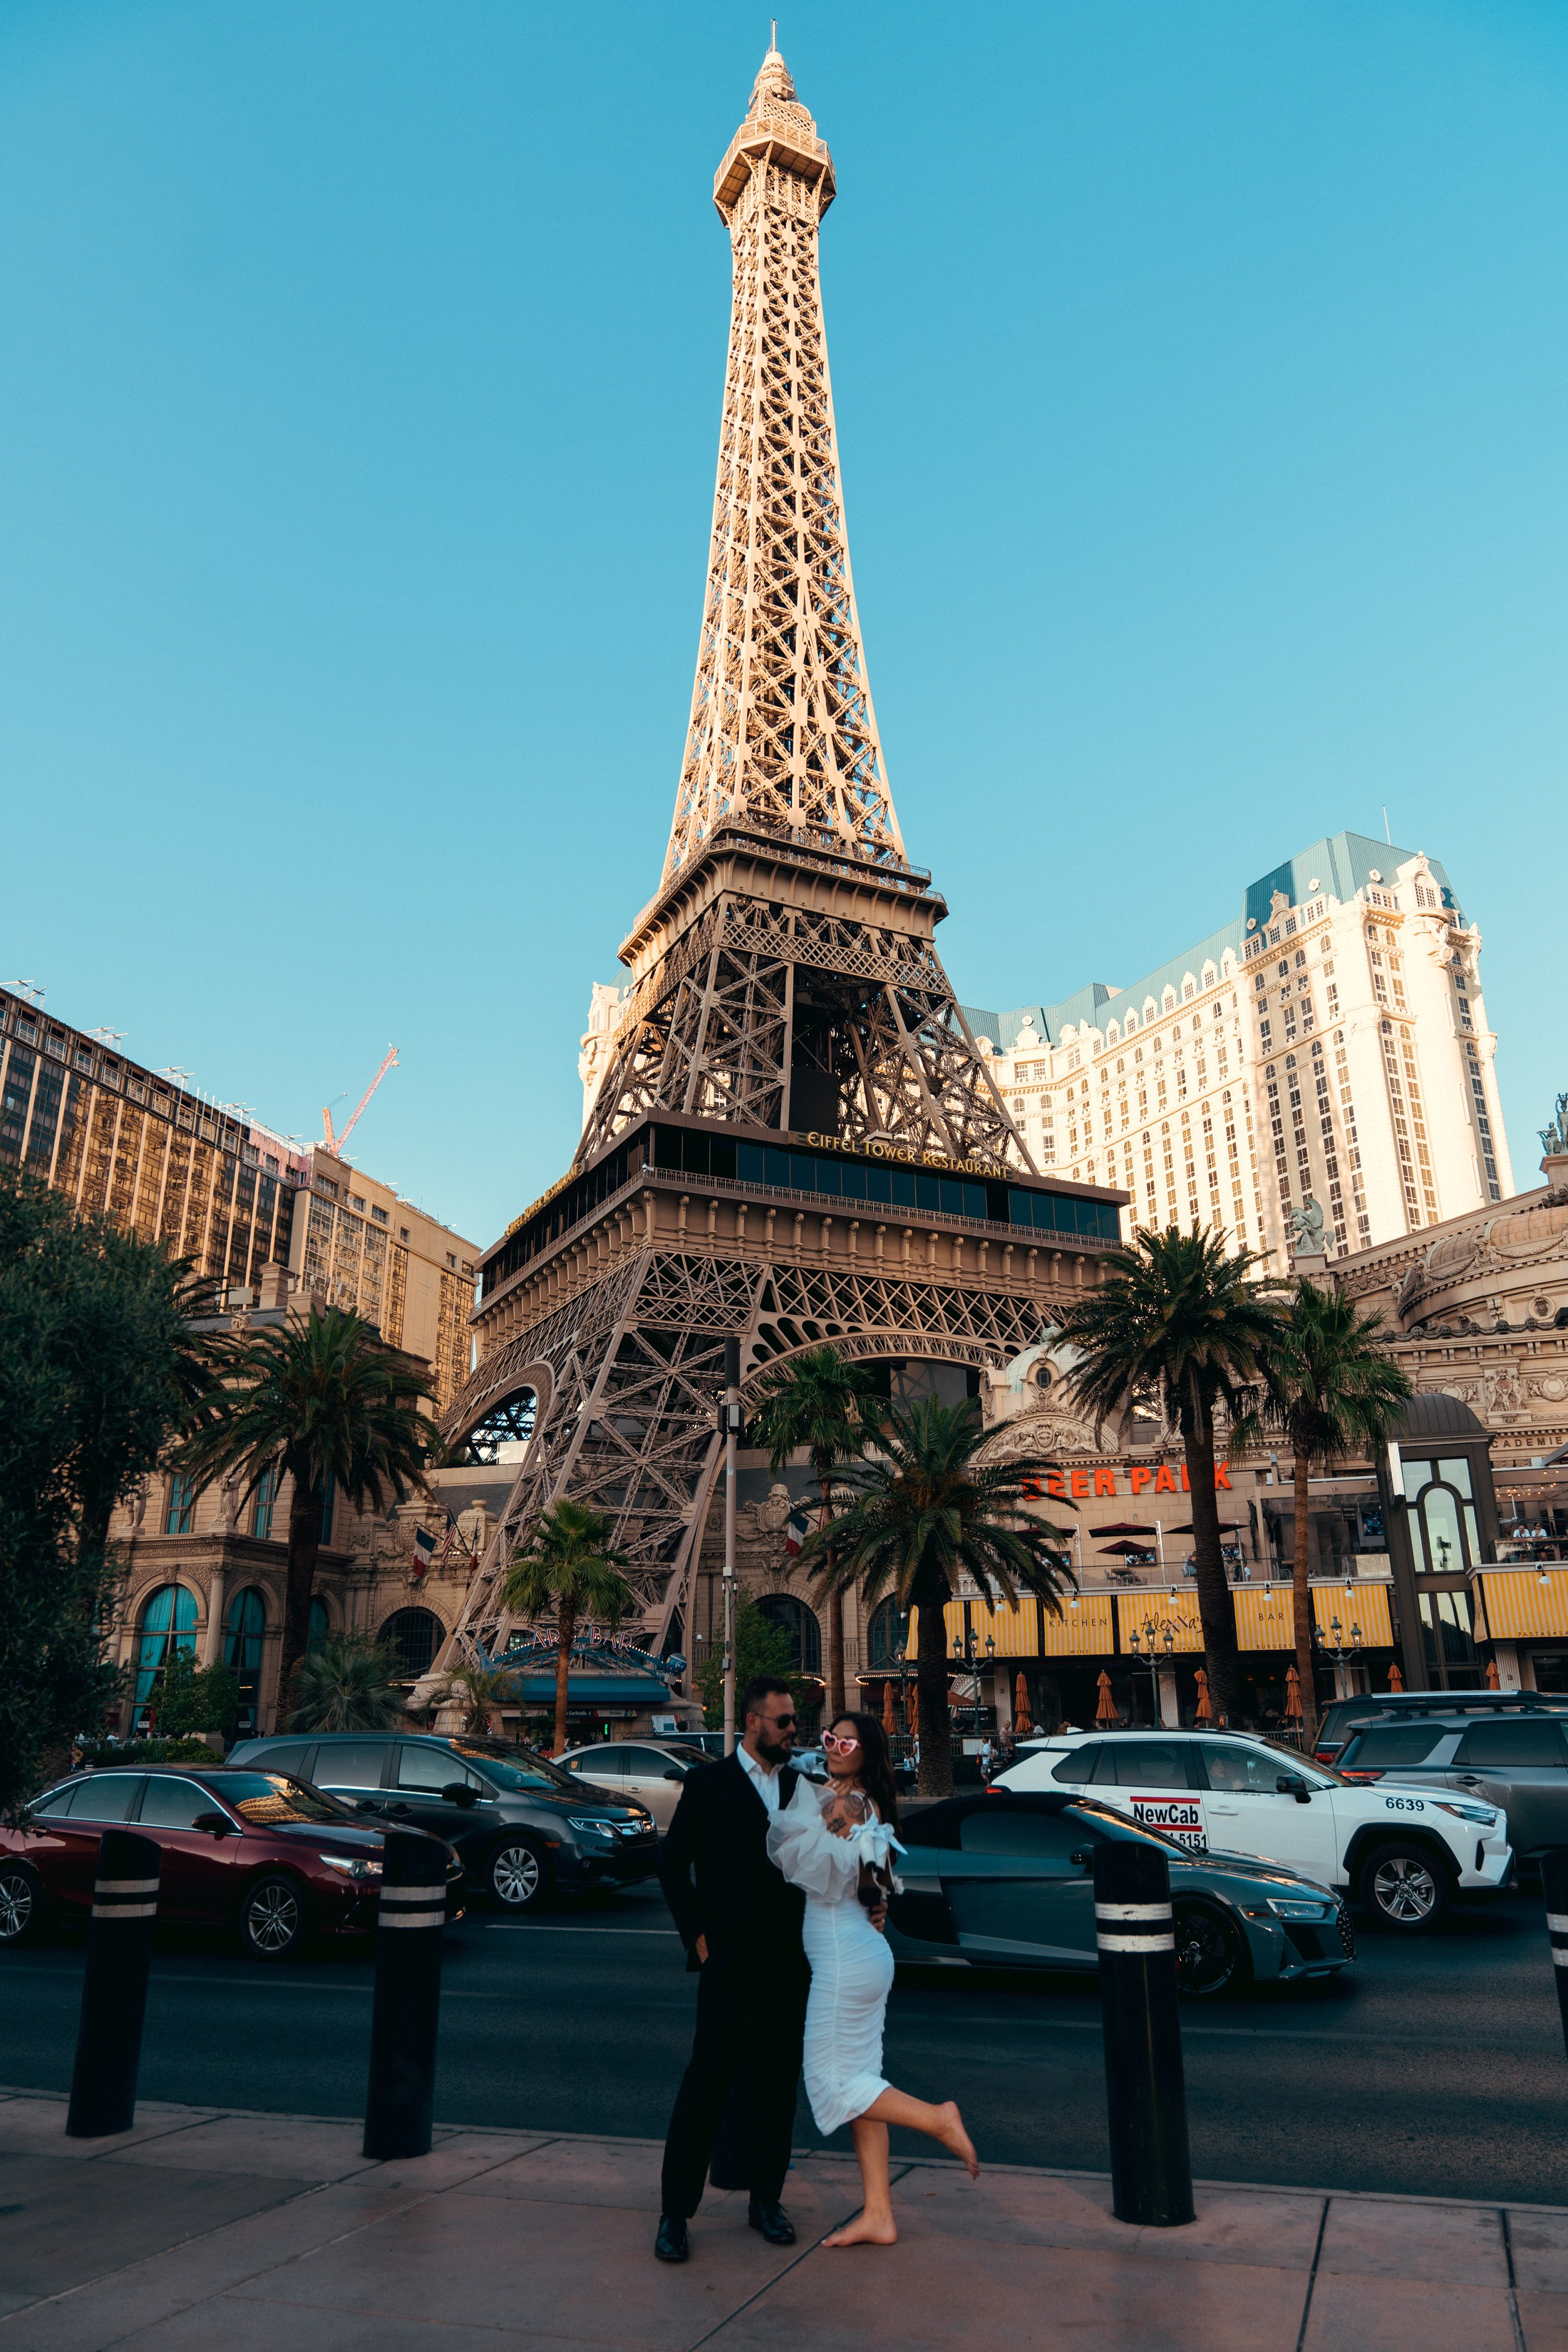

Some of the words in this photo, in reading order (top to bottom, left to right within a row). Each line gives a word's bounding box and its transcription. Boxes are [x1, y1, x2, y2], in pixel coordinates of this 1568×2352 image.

[806, 1131, 860, 1154] EIFFEL
[862, 1140, 917, 1163] TOWER
[921, 1150, 1009, 1180] RESTAURANT
[1491, 1435, 1563, 1448] CADEMIE
[1048, 1618, 1108, 1628] KITCHEN
[1258, 1612, 1285, 1621] BAR
[532, 1625, 577, 1650] AR
[590, 1626, 632, 1652] BAR
[1385, 1797, 1425, 1812] 6639
[1133, 1803, 1199, 1825] NewCab
[1179, 1833, 1207, 1848] 5151
